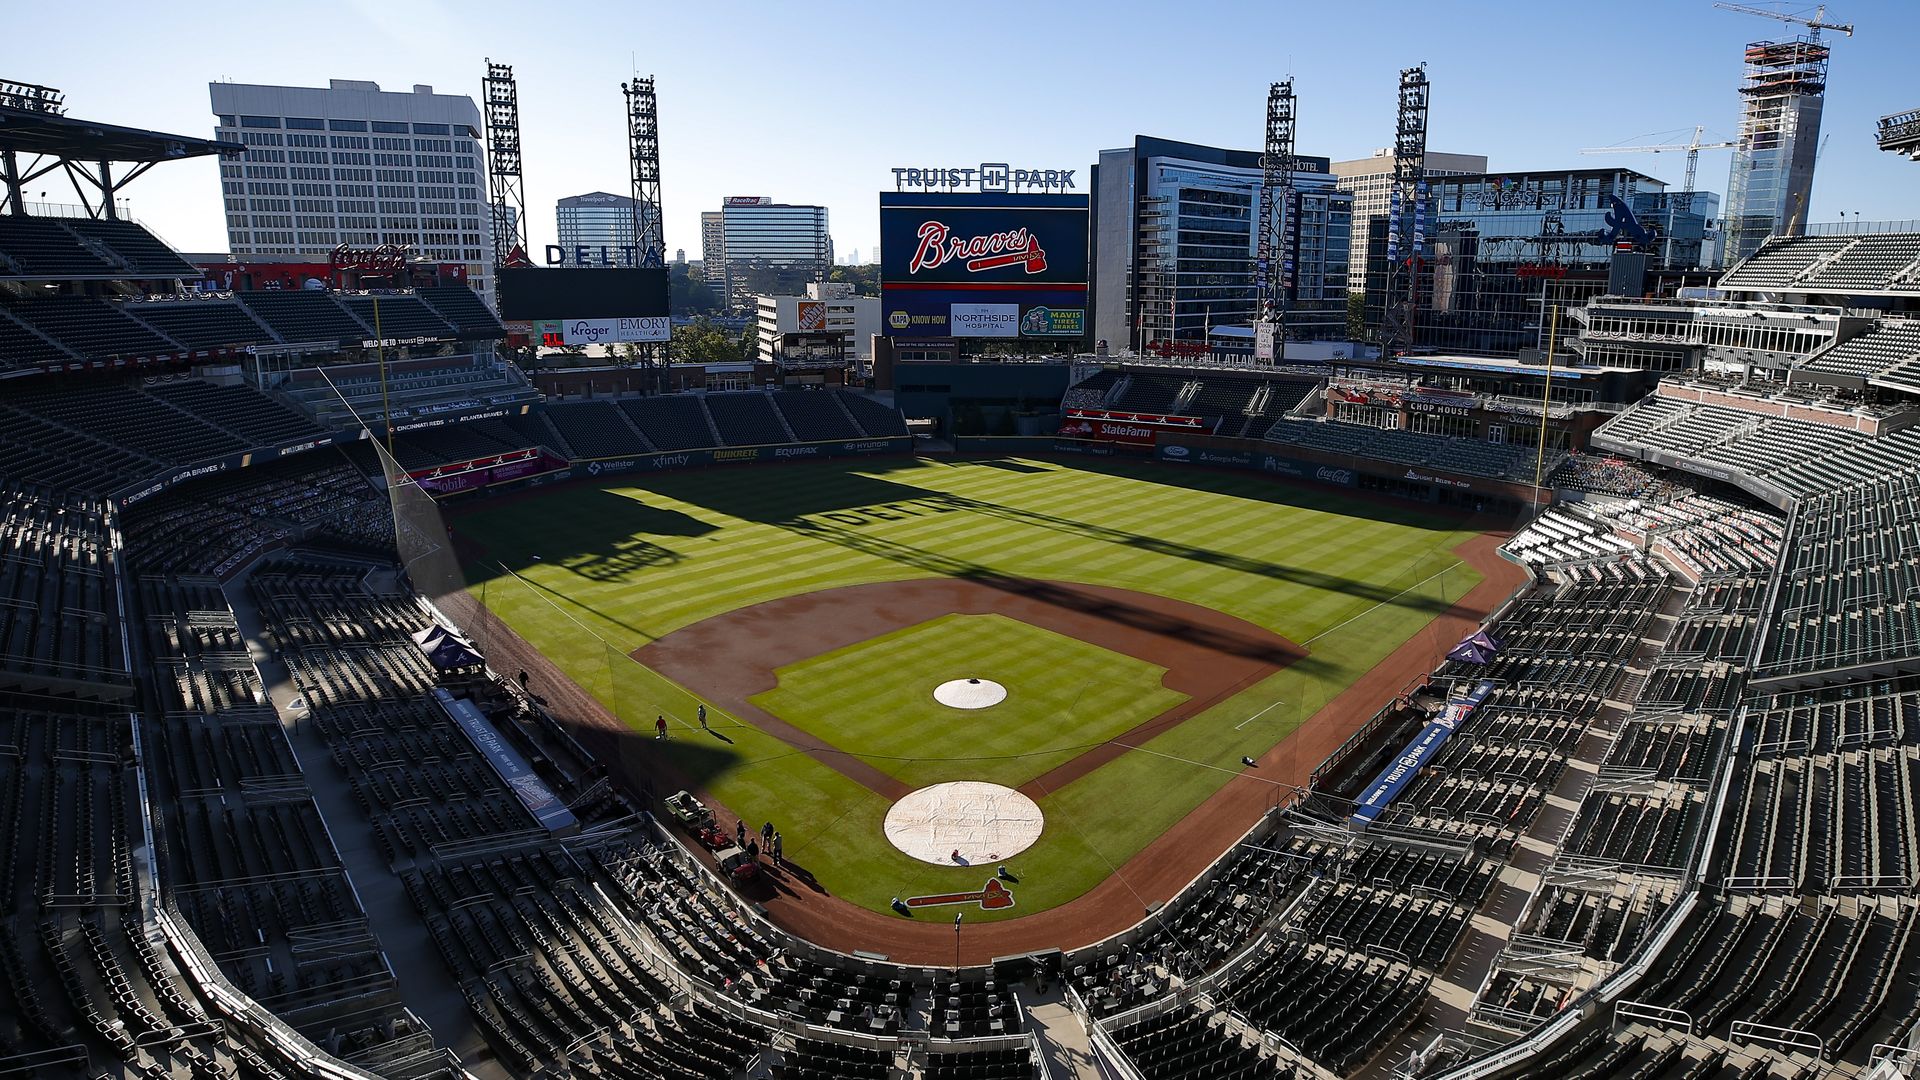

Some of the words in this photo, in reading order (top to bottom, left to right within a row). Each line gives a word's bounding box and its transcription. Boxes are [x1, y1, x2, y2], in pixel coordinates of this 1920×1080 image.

[1293, 159, 1318, 172] HOTEL
[892, 168, 976, 187] TRUIST
[1015, 169, 1076, 188] PARK
[910, 221, 1027, 274] Braves
[545, 244, 666, 266] DELTA
[620, 318, 668, 330] EMORY
[892, 315, 907, 324] NAPA
[911, 315, 931, 324] KNOW
[931, 315, 947, 324] HOW
[954, 314, 1016, 323] NORTHSIDE
[571, 321, 610, 342] Kroger
[362, 338, 388, 348] WELCME
[388, 338, 397, 347] TO
[245, 345, 257, 355] 42
[1410, 402, 1436, 413] CHOP
[1437, 406, 1470, 416] HOUSE
[397, 421, 429, 432] CINCINNATI
[460, 413, 483, 422] ATLANTA
[483, 410, 503, 419] BRAVES
[713, 448, 760, 460] QUIKRETE
[774, 446, 819, 458] EQUIFAX
[602, 460, 635, 469] Wellstar
[652, 453, 690, 469] xfinity
[1208, 454, 1231, 464] Georgia
[1231, 456, 1250, 464] Power
[192, 464, 218, 476] BRAVES
[1682, 462, 1714, 476] CINCINNATI
[1384, 763, 1410, 785] TRUIST
[1408, 744, 1428, 763] PARK
